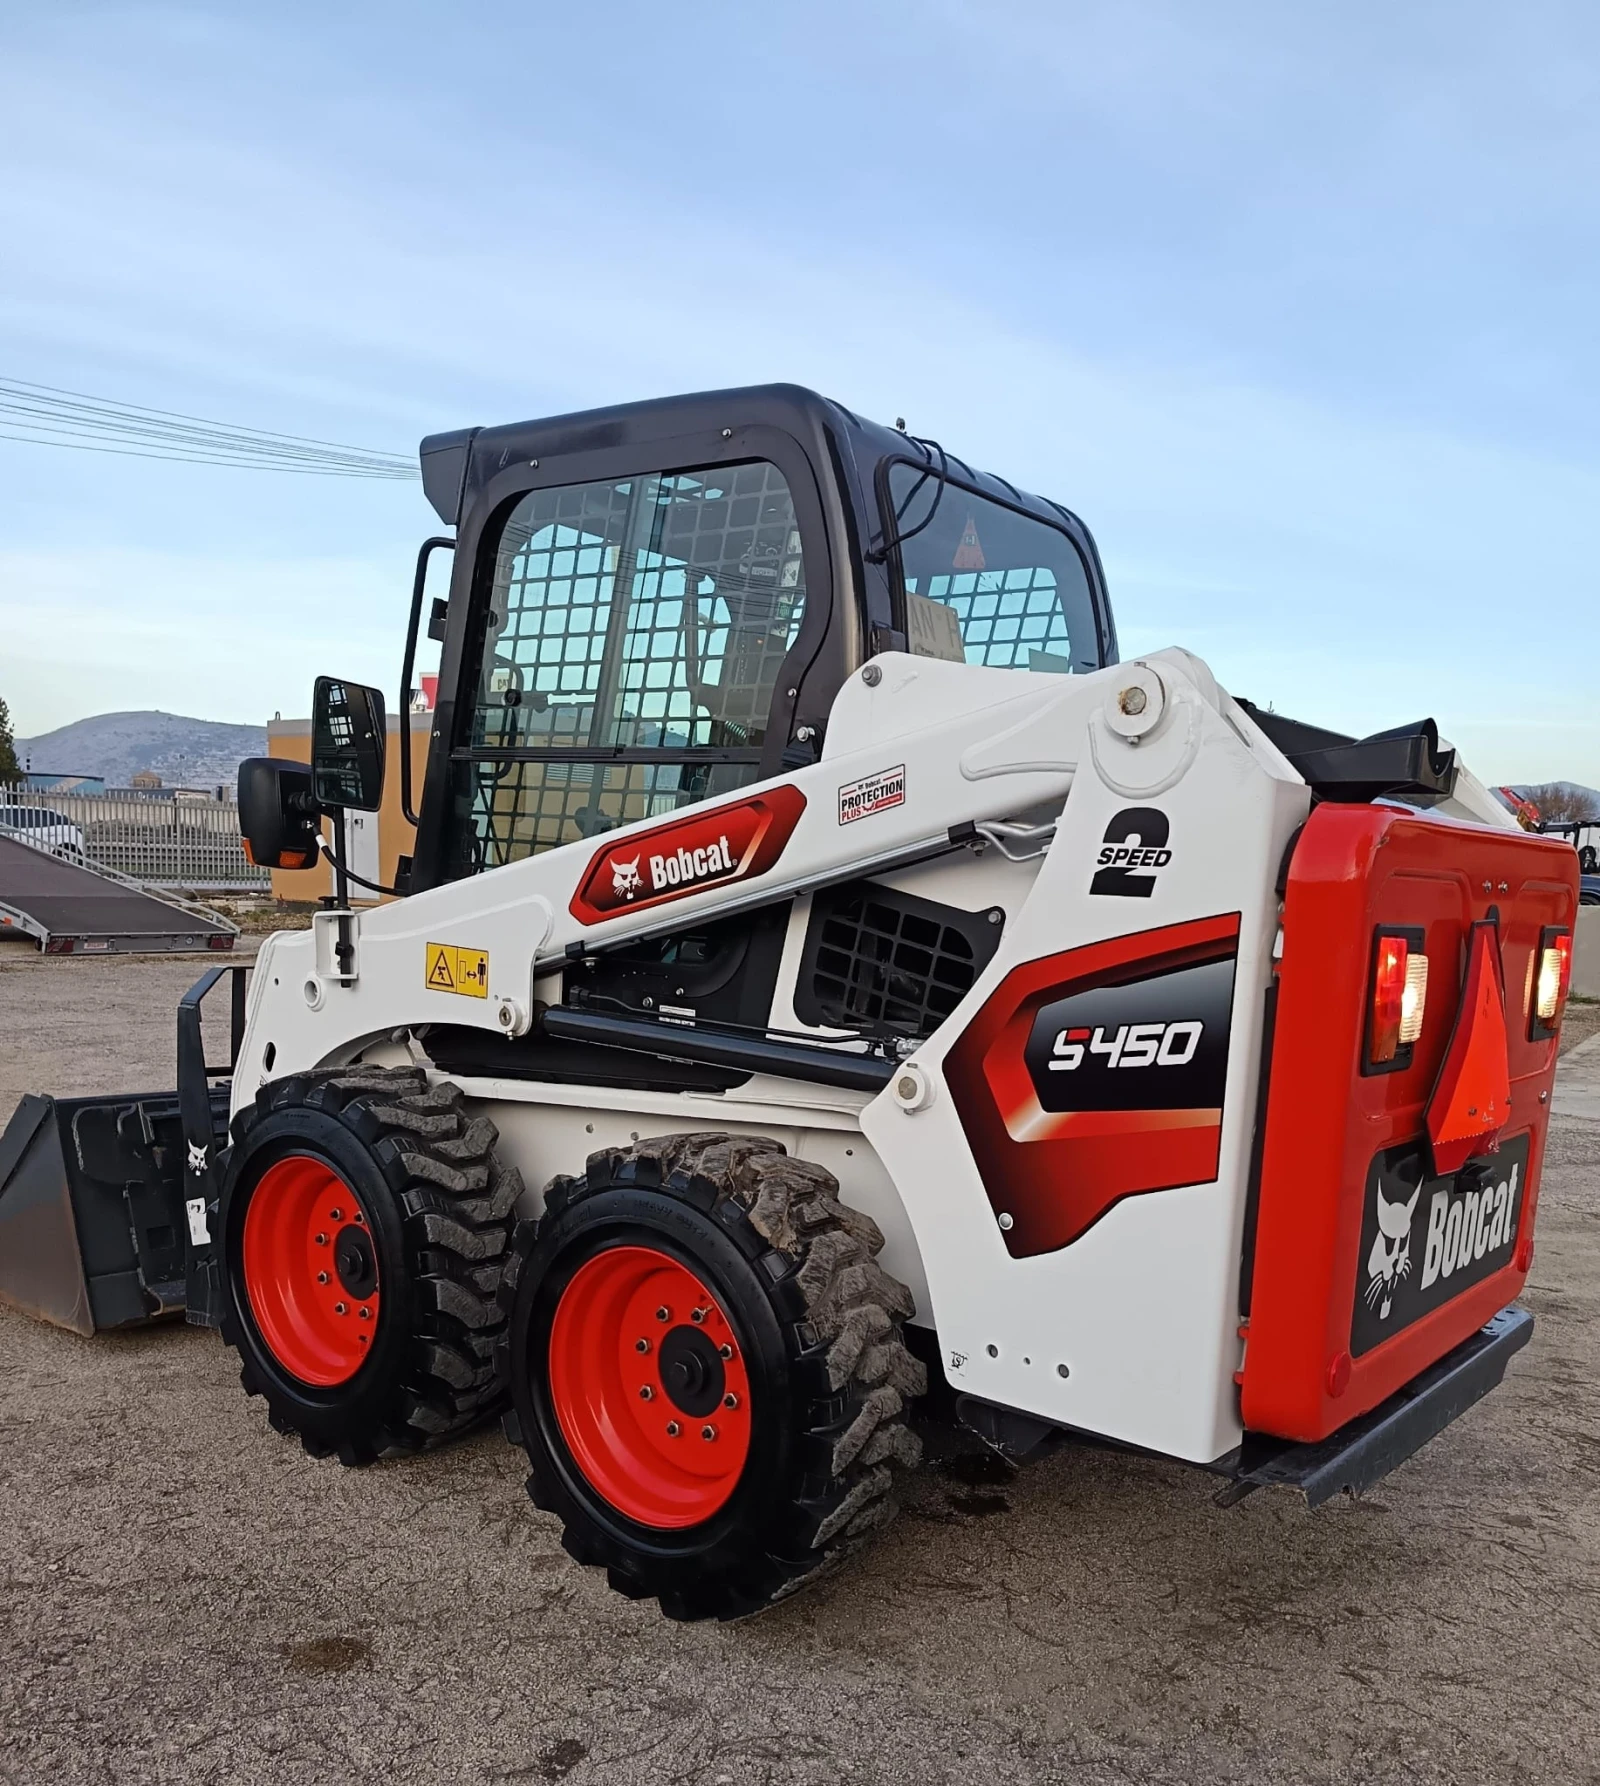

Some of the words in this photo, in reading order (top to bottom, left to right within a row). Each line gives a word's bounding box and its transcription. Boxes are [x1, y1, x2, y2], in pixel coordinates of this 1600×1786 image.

[841, 779, 903, 812] PROTECTION
[864, 778, 882, 790] Bobcat
[841, 806, 862, 822] PLUS
[649, 835, 732, 890] Bobcat
[1089, 807, 1170, 898] 2
[1097, 847, 1172, 867] SPEED
[1048, 1021, 1204, 1071] S450
[1420, 1162, 1519, 1291] Bobcat
